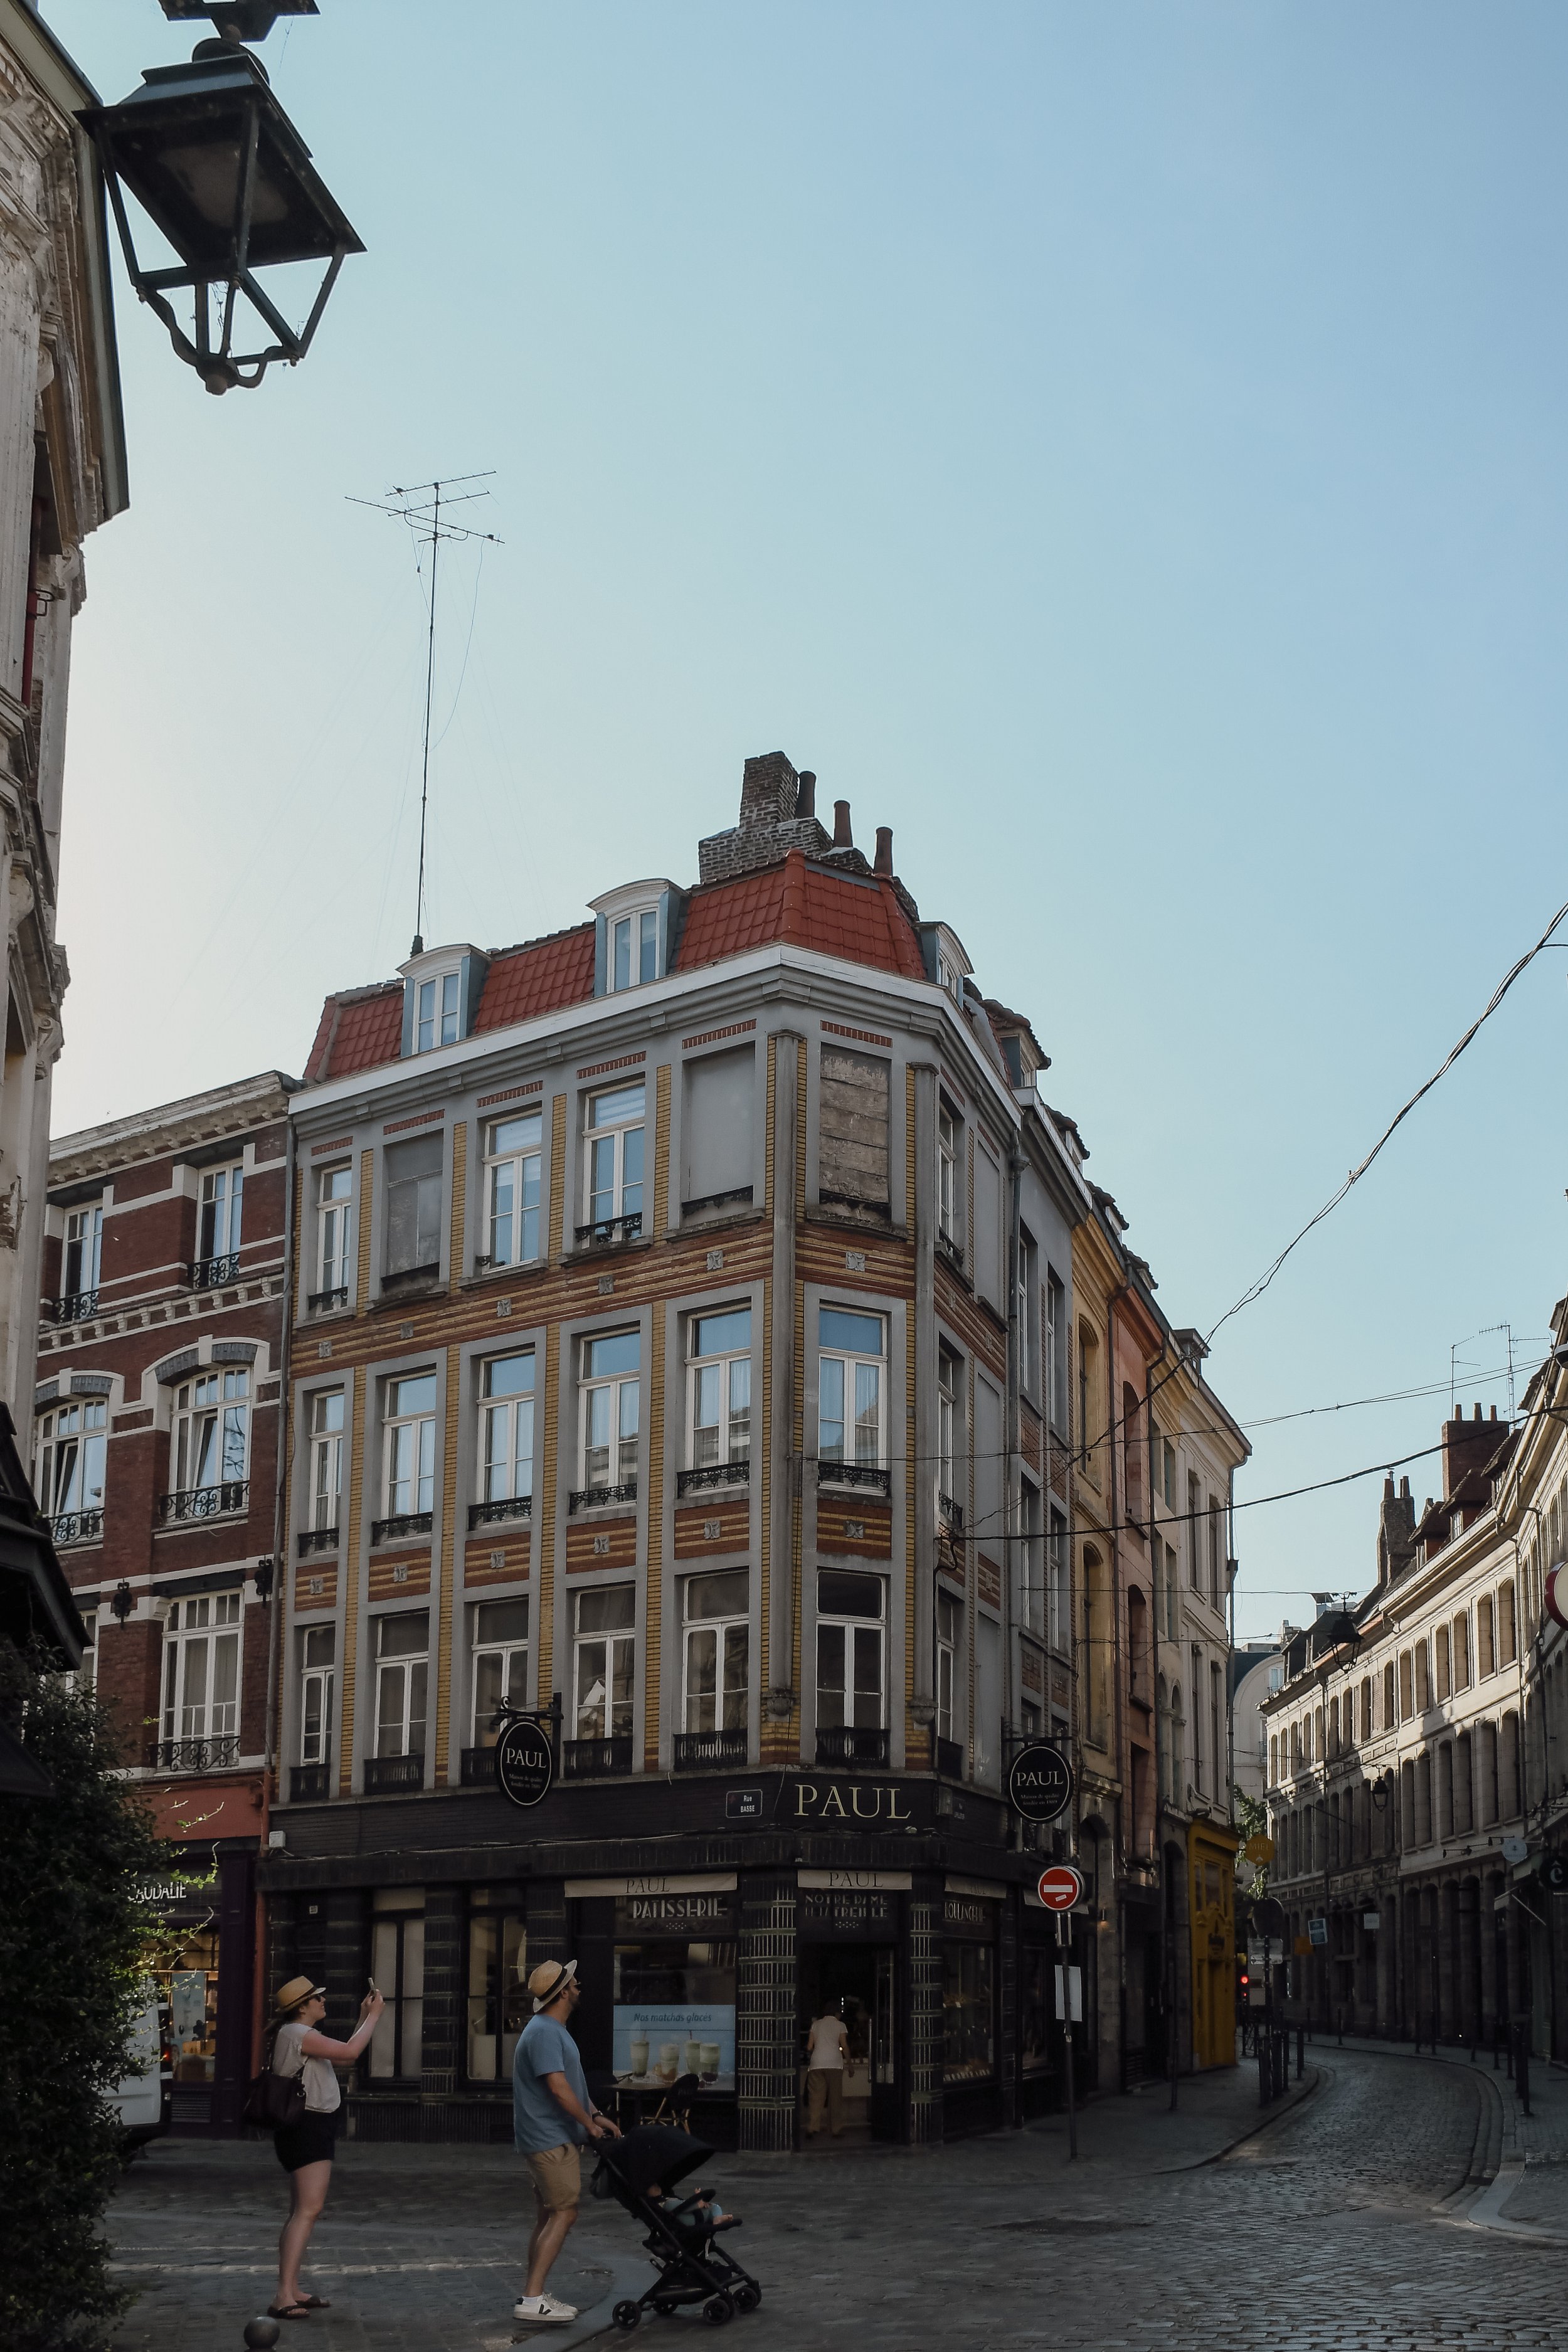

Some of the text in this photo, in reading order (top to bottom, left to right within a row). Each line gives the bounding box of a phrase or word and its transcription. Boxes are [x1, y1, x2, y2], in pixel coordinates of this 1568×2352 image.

[506, 1747, 547, 1768] PAUL
[1016, 1771, 1064, 1786] PAUL
[740, 1804, 755, 1813] BASSE
[794, 1784, 911, 1819] PAUL
[626, 1877, 670, 1894] PAUL
[829, 1872, 883, 1887] PAUL
[805, 1894, 850, 1904] NOTRE
[633, 1898, 728, 1919] PATISSERIE
[634, 2012, 712, 2023] Nos matchas glacés
